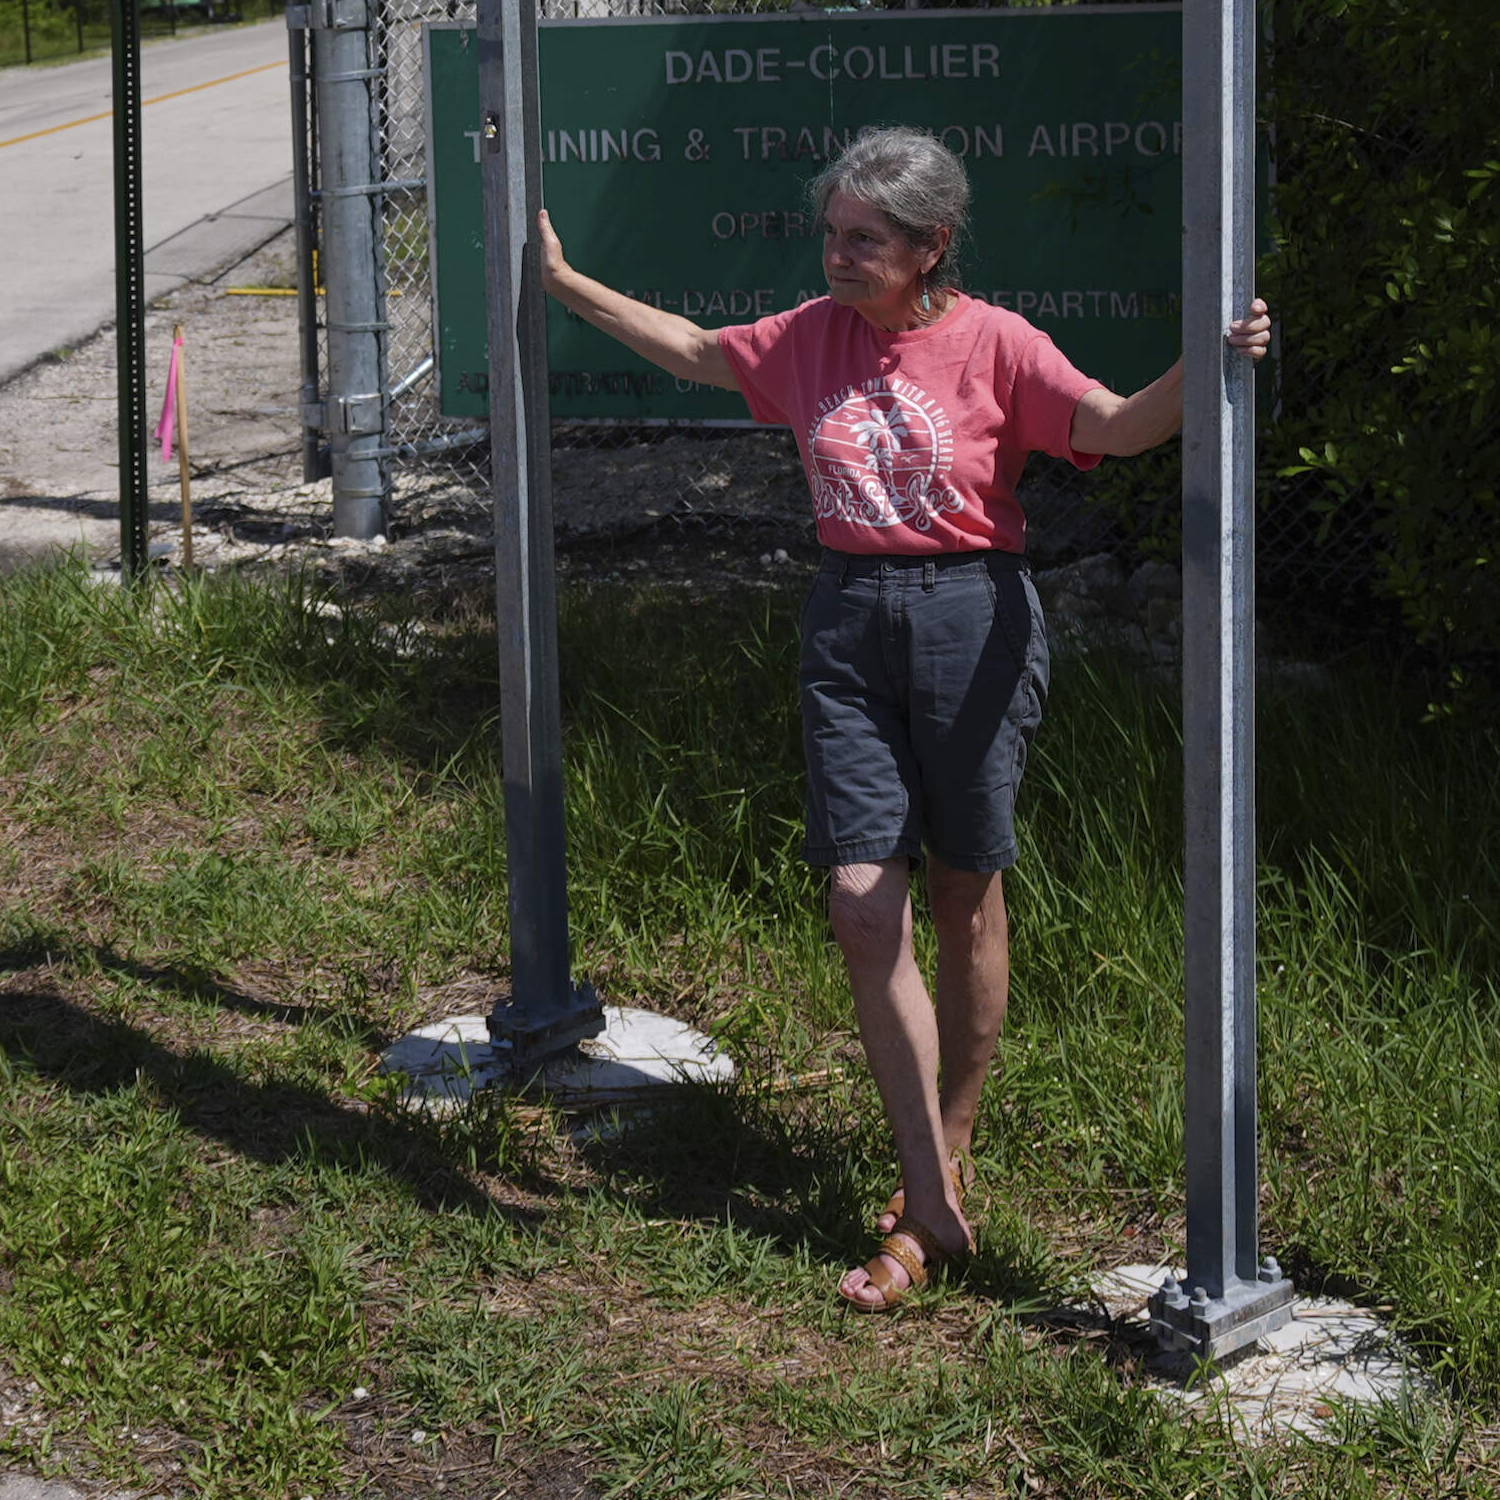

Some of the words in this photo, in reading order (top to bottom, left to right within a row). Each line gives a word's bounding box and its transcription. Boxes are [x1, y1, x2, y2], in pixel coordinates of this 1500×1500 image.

[665, 42, 1000, 85] DADE-COLLIER
[464, 127, 662, 165] TINING
[684, 127, 711, 160] &
[733, 124, 1004, 161] TRANON
[891, 378, 927, 402] WITH
[828, 463, 861, 479] FLORIDA
